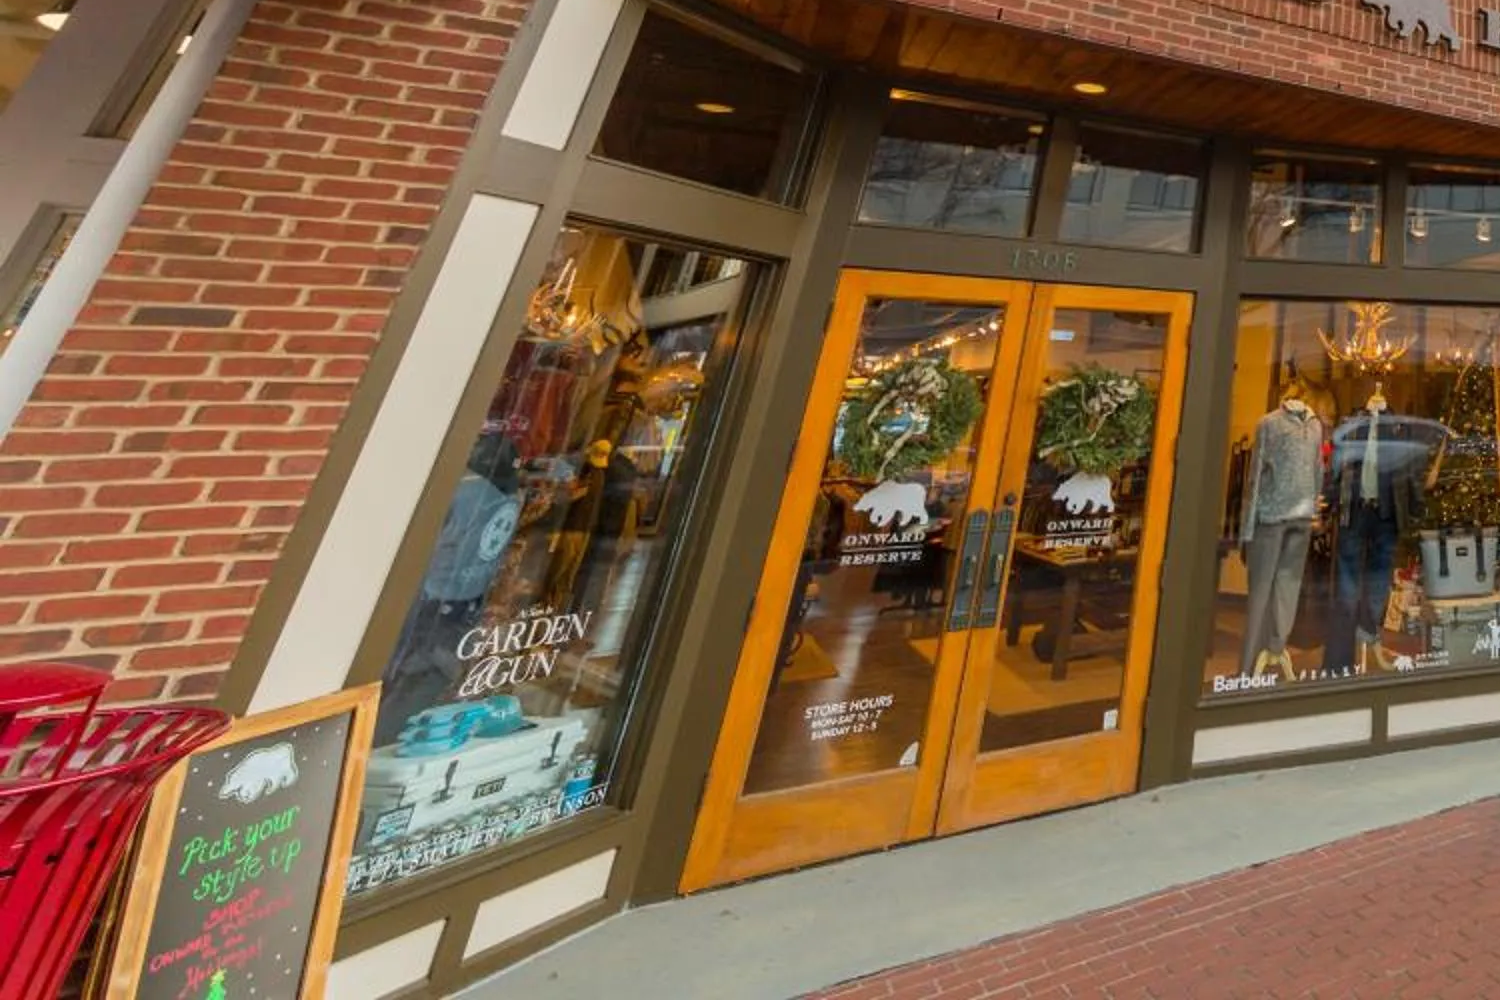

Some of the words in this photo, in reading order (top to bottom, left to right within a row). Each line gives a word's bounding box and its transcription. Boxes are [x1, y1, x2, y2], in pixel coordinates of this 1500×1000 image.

[1047, 519, 1113, 531] ONWARD
[845, 531, 925, 546] ONWARD
[1044, 535, 1111, 548] RESERVE
[840, 551, 922, 565] RESERVE
[457, 611, 592, 660] GARDEN
[1213, 672, 1278, 692] Barbour
[804, 702, 848, 719] STORE
[849, 694, 894, 712] HOURS
[811, 726, 851, 740] SUNDAY
[179, 827, 239, 876] Pick
[244, 805, 300, 853] your
[192, 853, 264, 903] style
[269, 839, 301, 874] up
